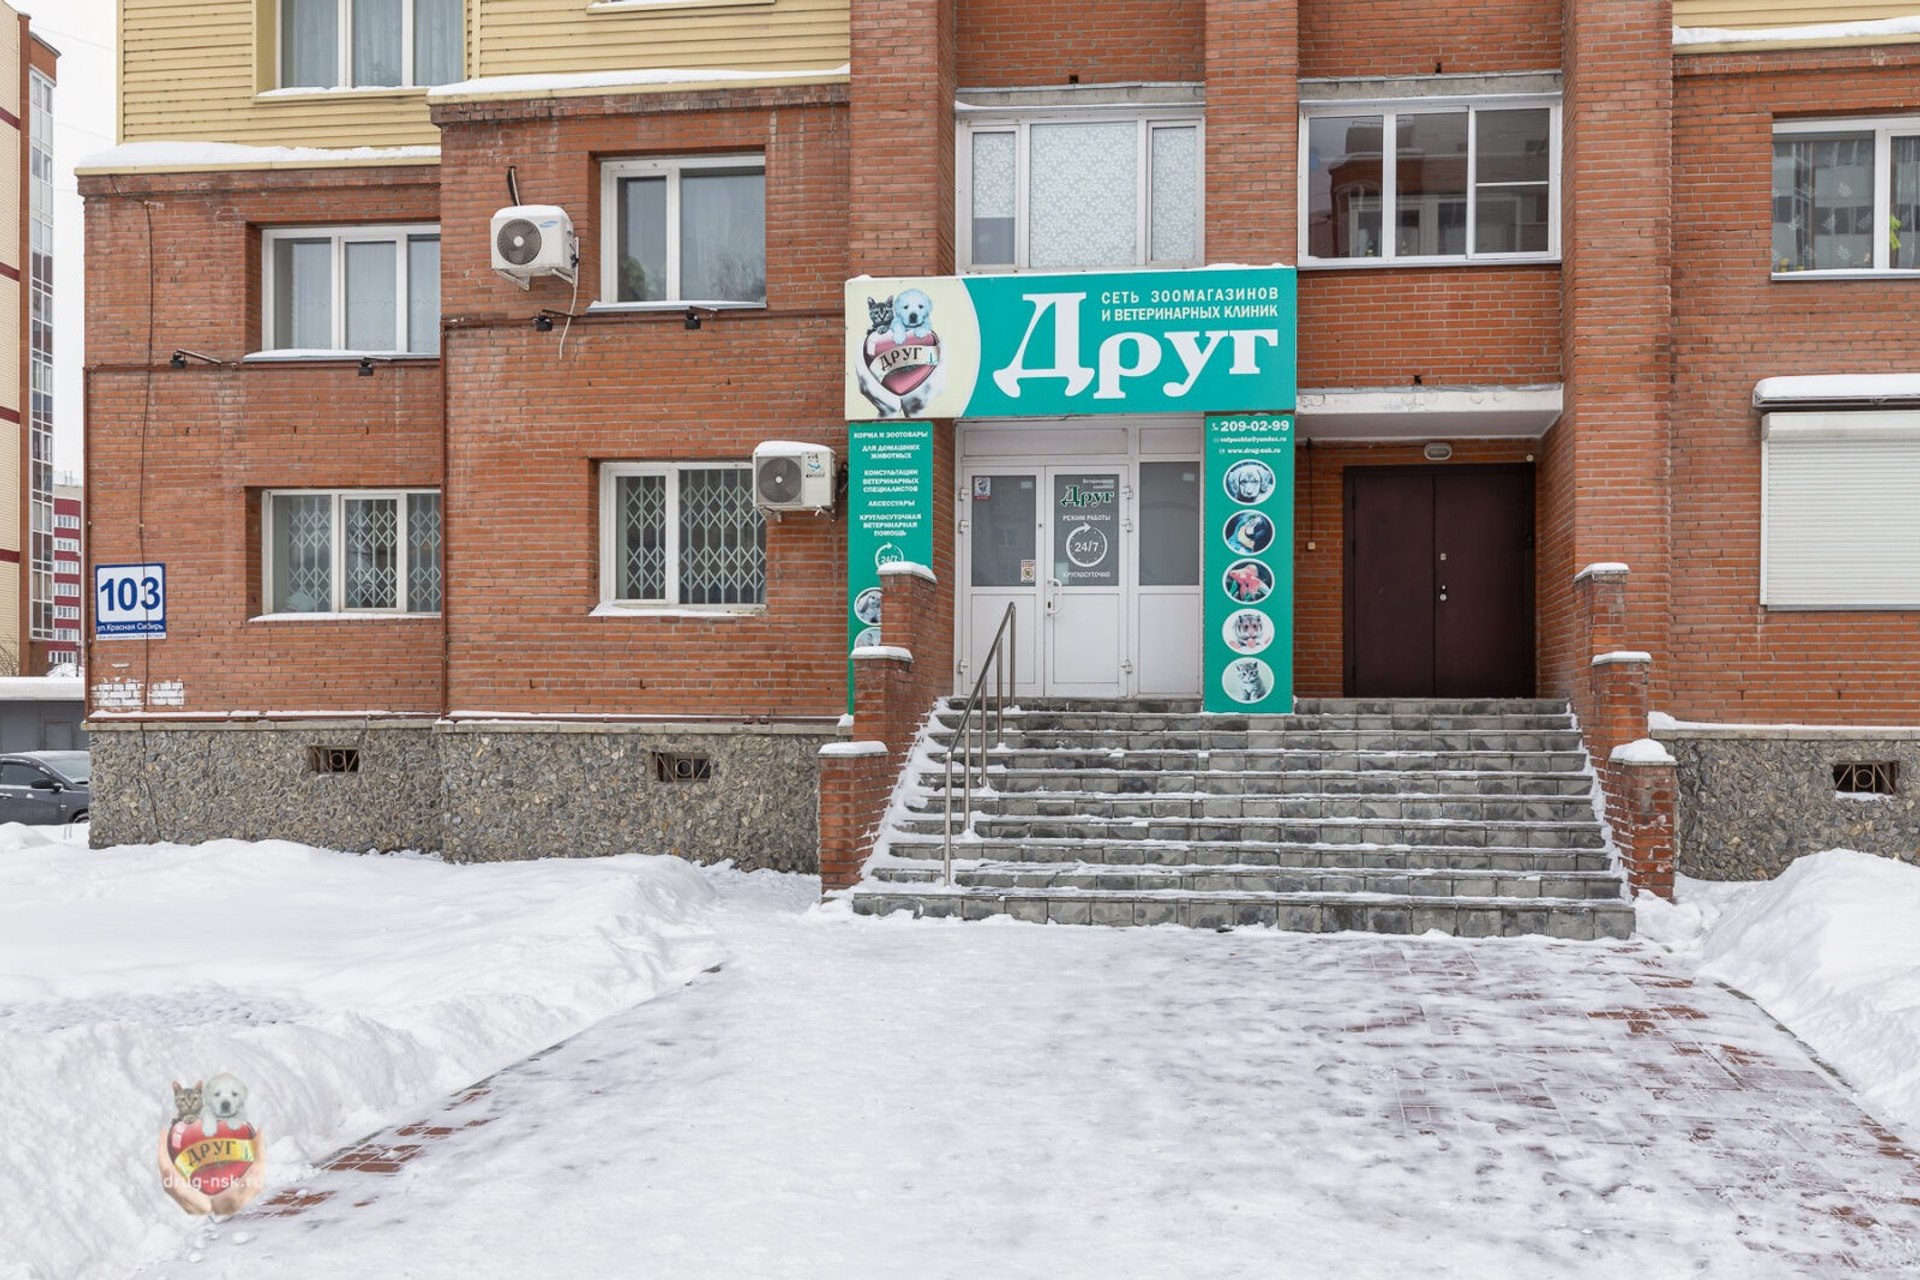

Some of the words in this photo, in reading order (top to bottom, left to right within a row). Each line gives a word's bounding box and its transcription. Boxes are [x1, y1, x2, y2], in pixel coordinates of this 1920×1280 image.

[1101, 290, 1140, 305] СЕТЬ
[1151, 287, 1279, 302] ЗООМАГАЗИНОВ
[1101, 309, 1111, 322] И
[1114, 306, 1220, 321] ВЕТЕРИНАРНЫХ
[1222, 304, 1278, 319] КЛИНИК
[992, 292, 1279, 399] Друг
[879, 346, 923, 371] ДРУГ
[1220, 420, 1290, 432] 209-02-99
[878, 444, 920, 453] ДОМАШНИХ
[1060, 485, 1115, 507] Друг
[1074, 540, 1099, 552] 24/7
[100, 577, 161, 611] 103
[136, 622, 164, 631] Сибирь
